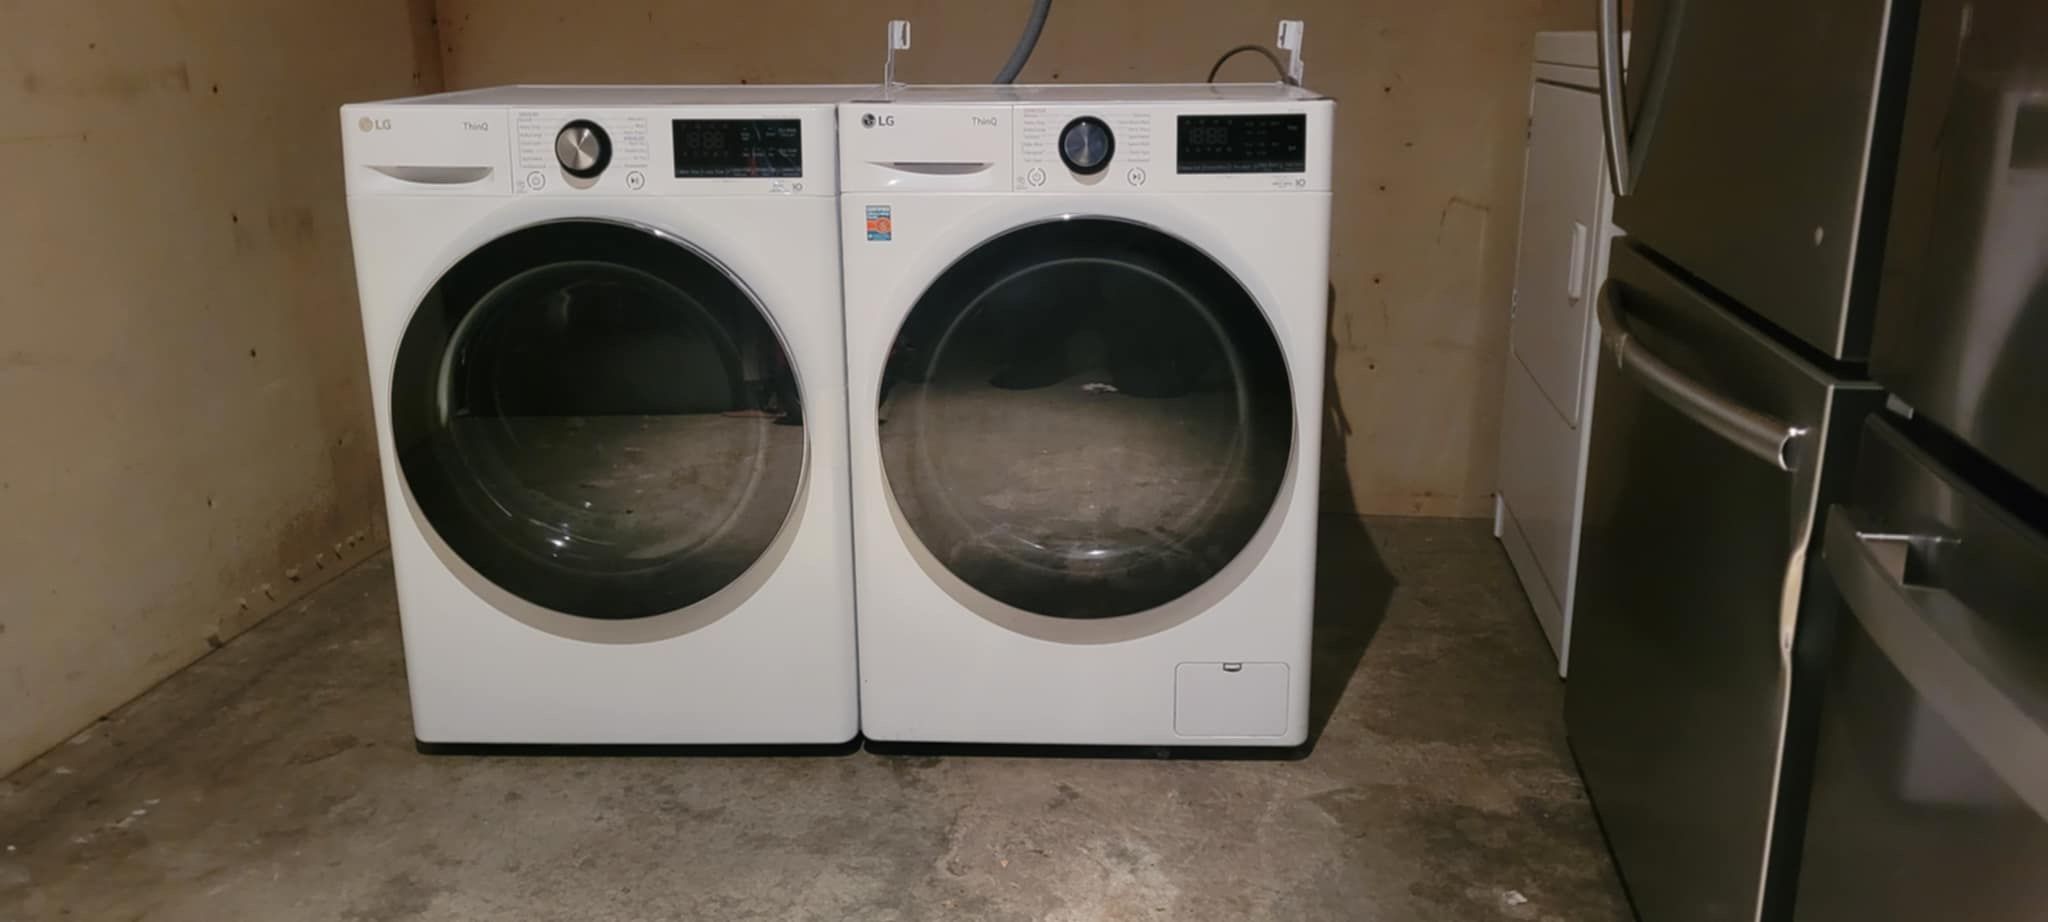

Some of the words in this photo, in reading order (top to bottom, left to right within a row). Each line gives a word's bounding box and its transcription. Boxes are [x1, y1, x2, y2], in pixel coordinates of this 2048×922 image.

[878, 115, 895, 127] LG
[972, 117, 998, 127] ThinQ
[464, 122, 489, 131] ThinQ
